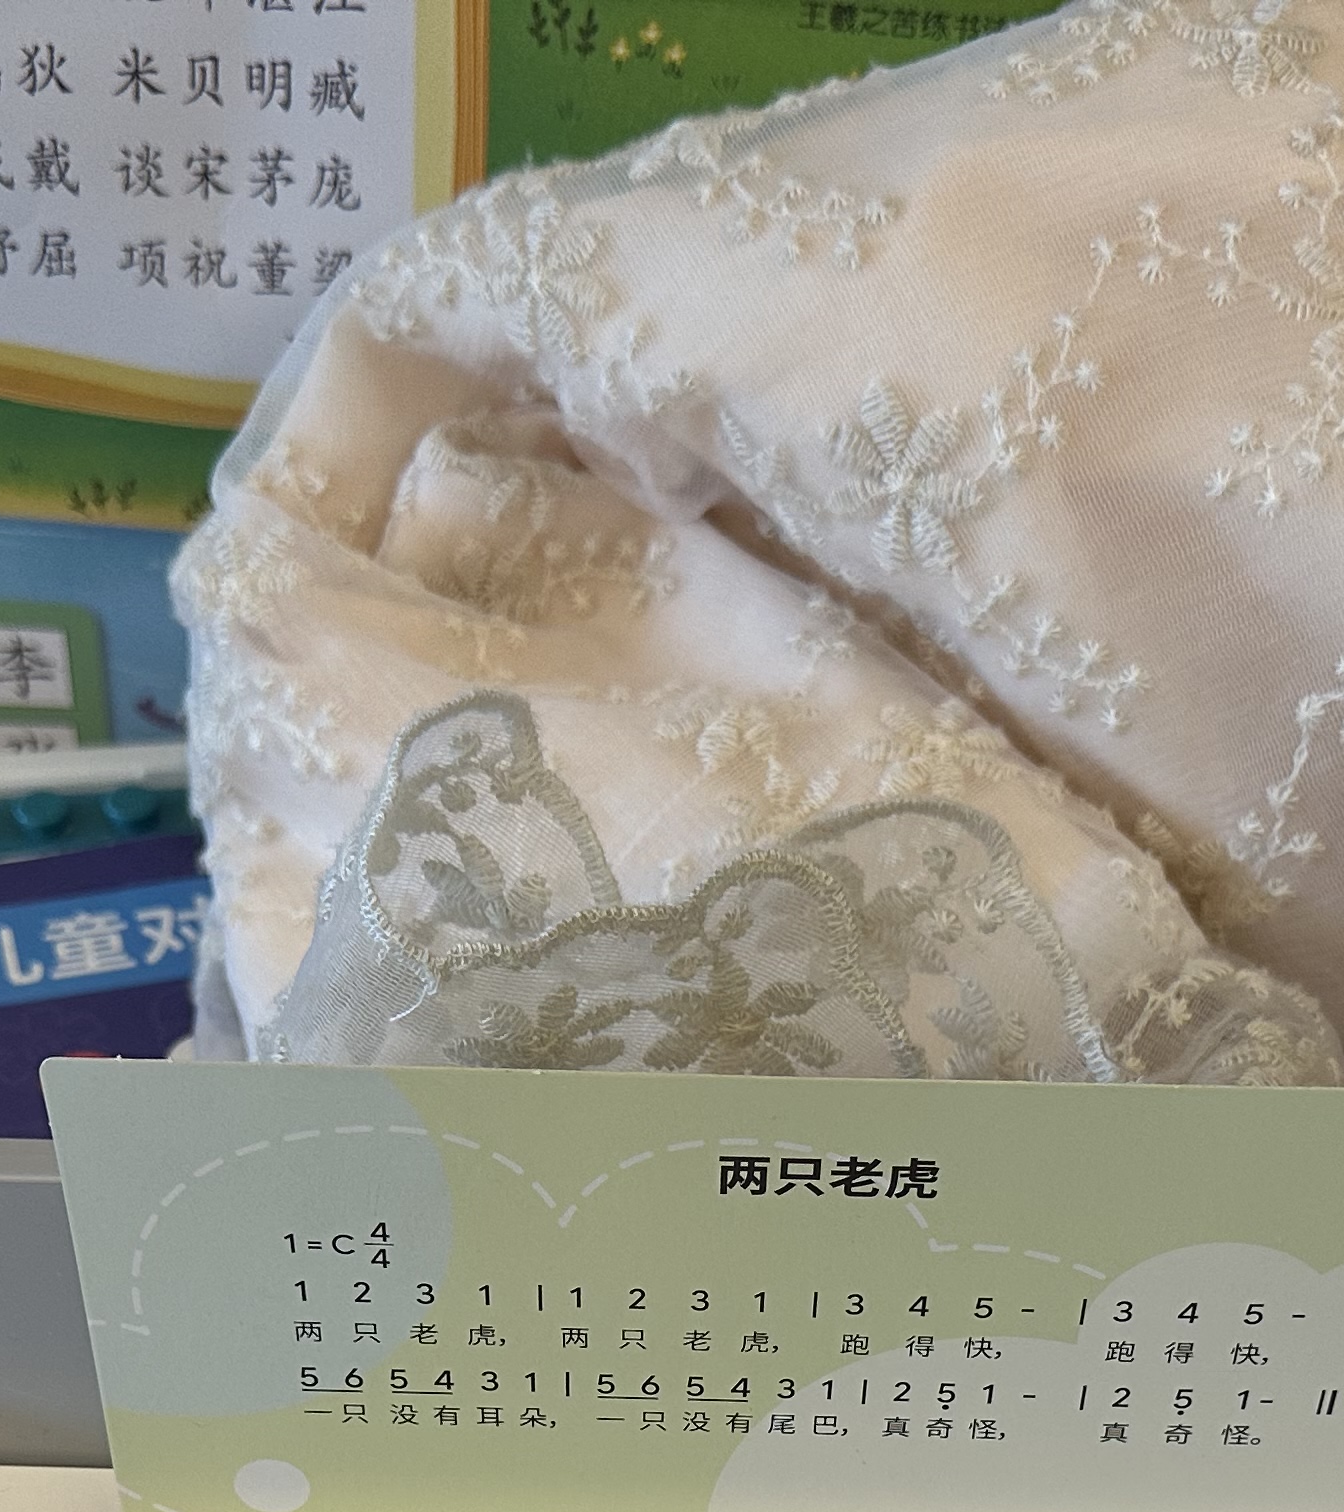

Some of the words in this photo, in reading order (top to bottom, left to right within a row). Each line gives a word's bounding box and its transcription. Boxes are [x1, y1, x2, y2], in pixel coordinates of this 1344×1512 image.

[114, 46, 366, 121] 米贝明臧
[114, 144, 362, 212] 谈宋茅庞
[718, 1155, 940, 1199] 两只老虎
